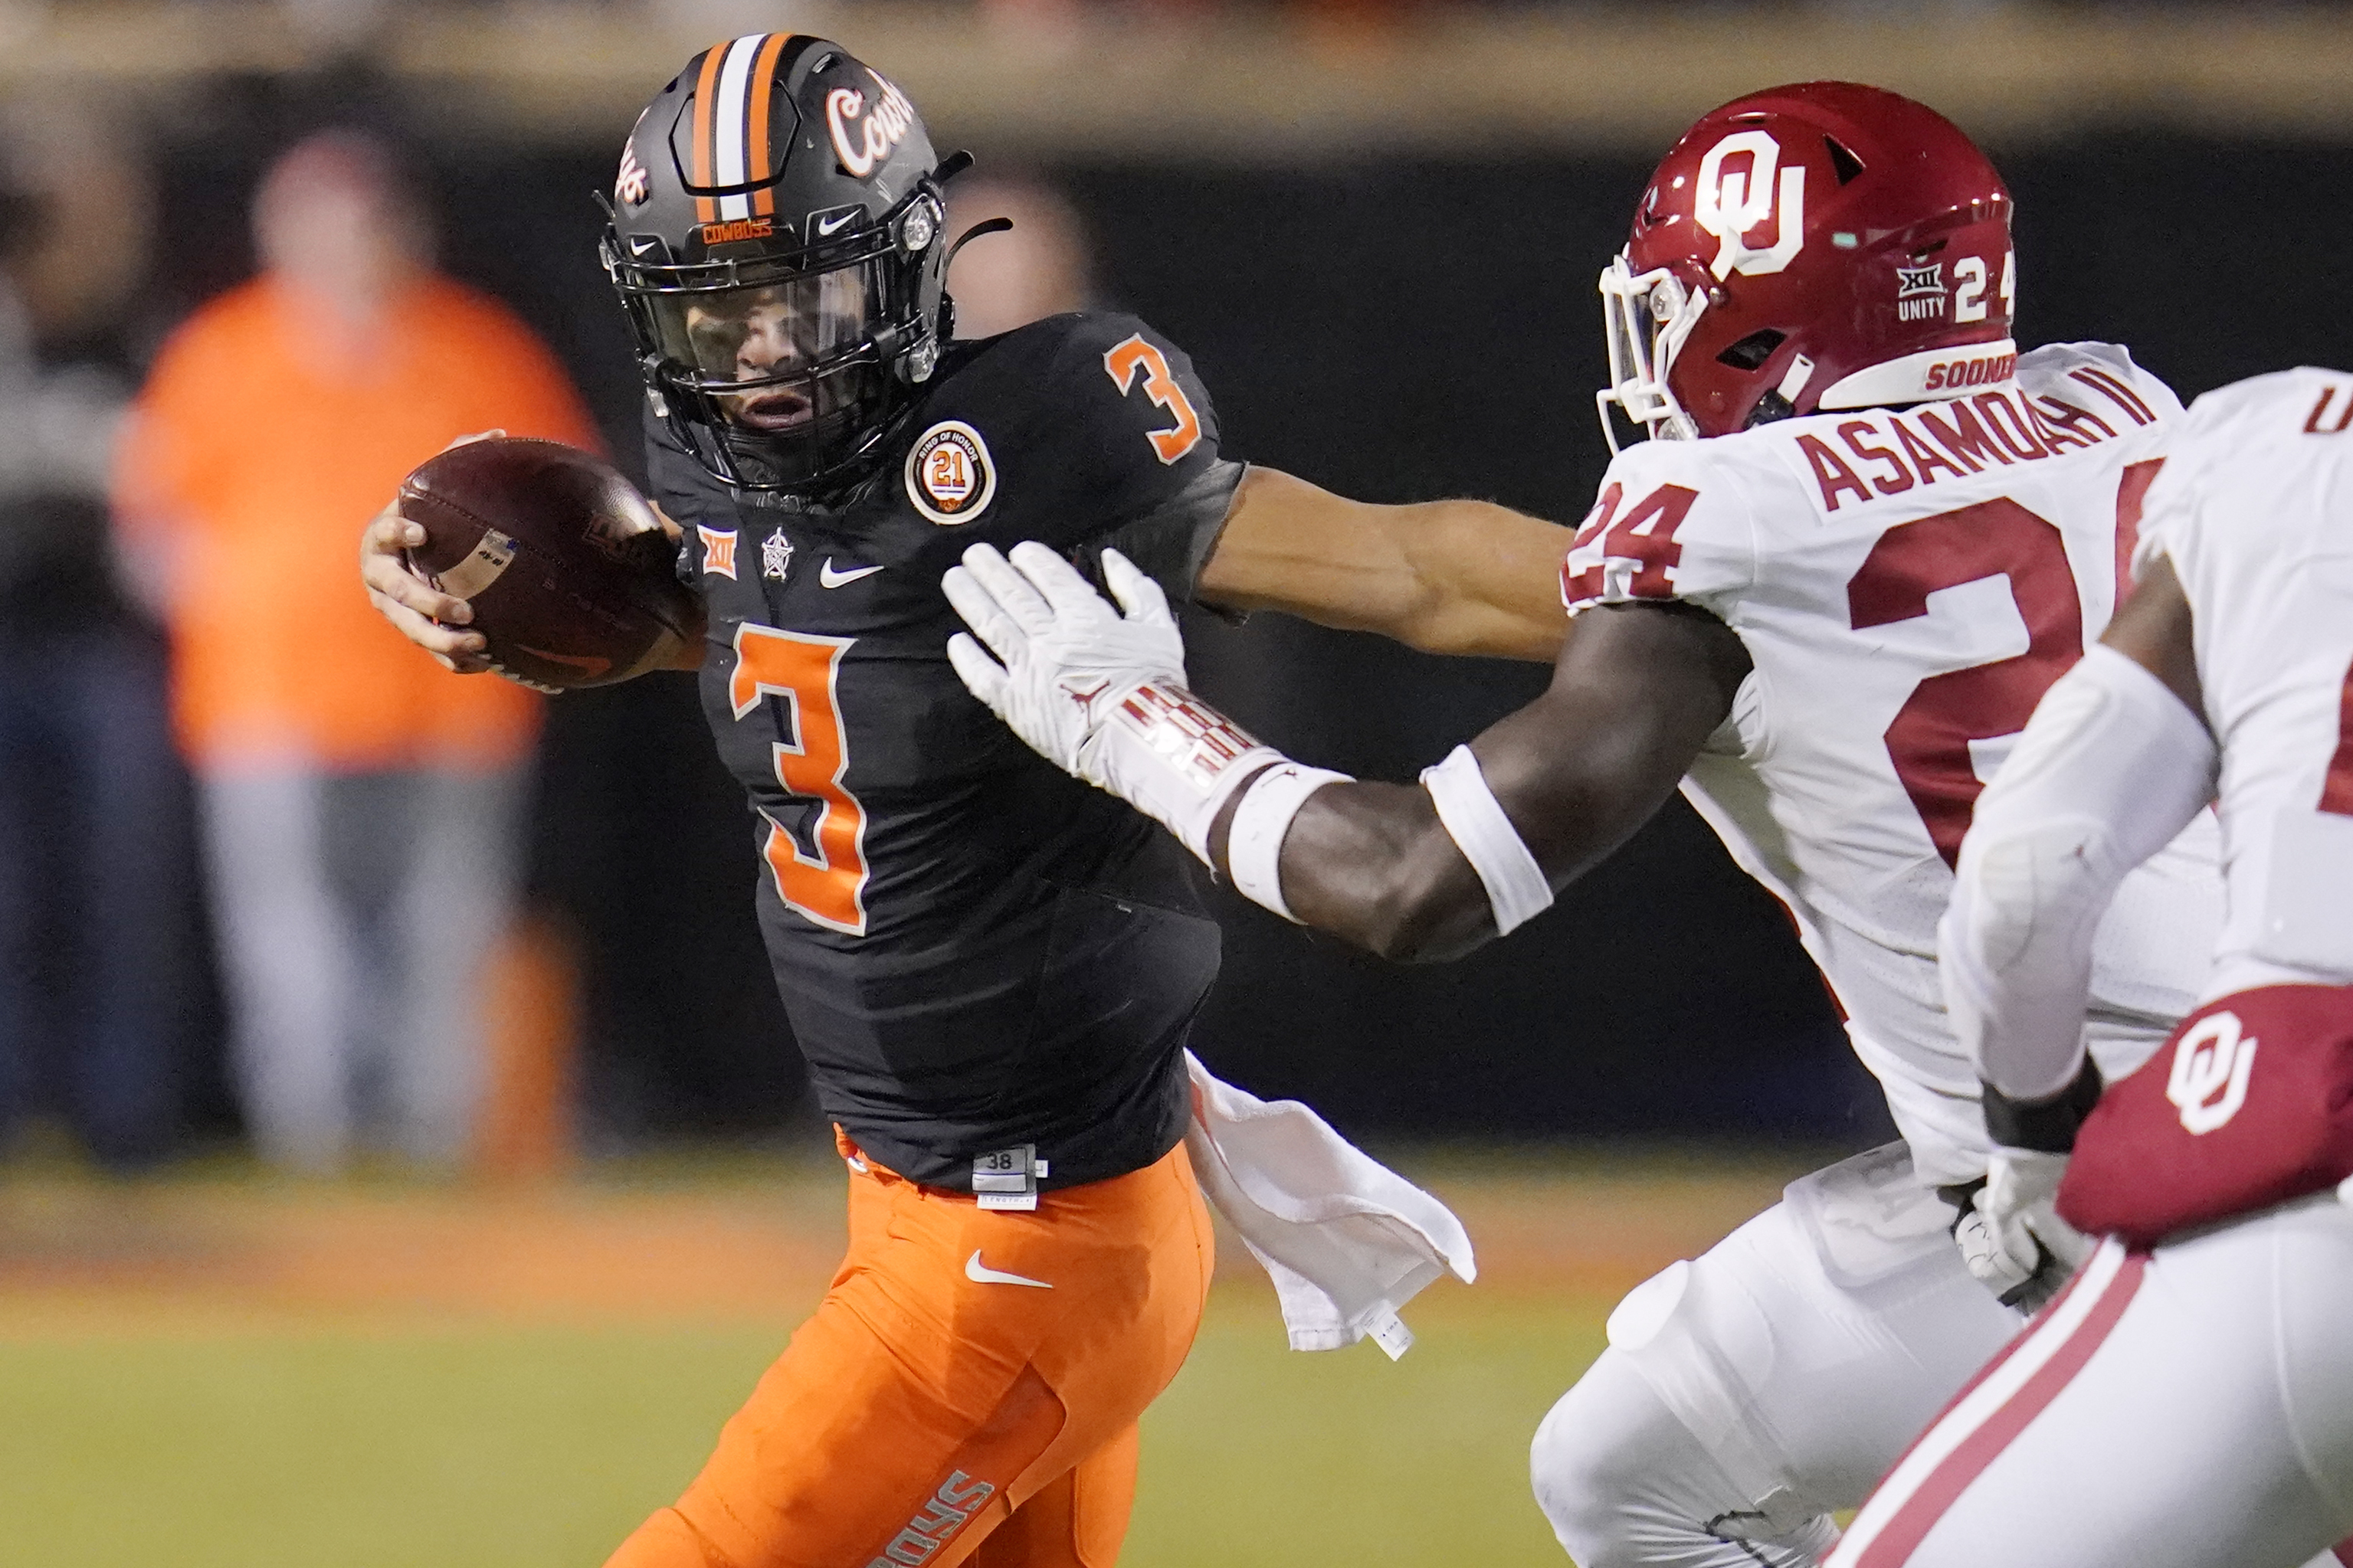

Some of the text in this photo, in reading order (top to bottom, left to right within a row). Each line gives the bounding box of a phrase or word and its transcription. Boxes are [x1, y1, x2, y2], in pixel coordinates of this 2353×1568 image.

[1694, 129, 1806, 282] OU
[1899, 296, 1945, 322] UNITY
[919, 431, 978, 463] RING OF HONOR
[1102, 332, 1201, 466] 3
[1794, 388, 2118, 512] ASAMOAH
[932, 450, 966, 487] 21
[1562, 481, 1700, 605] 24
[729, 621, 870, 937] 3
[987, 1153, 1013, 1170] 38
